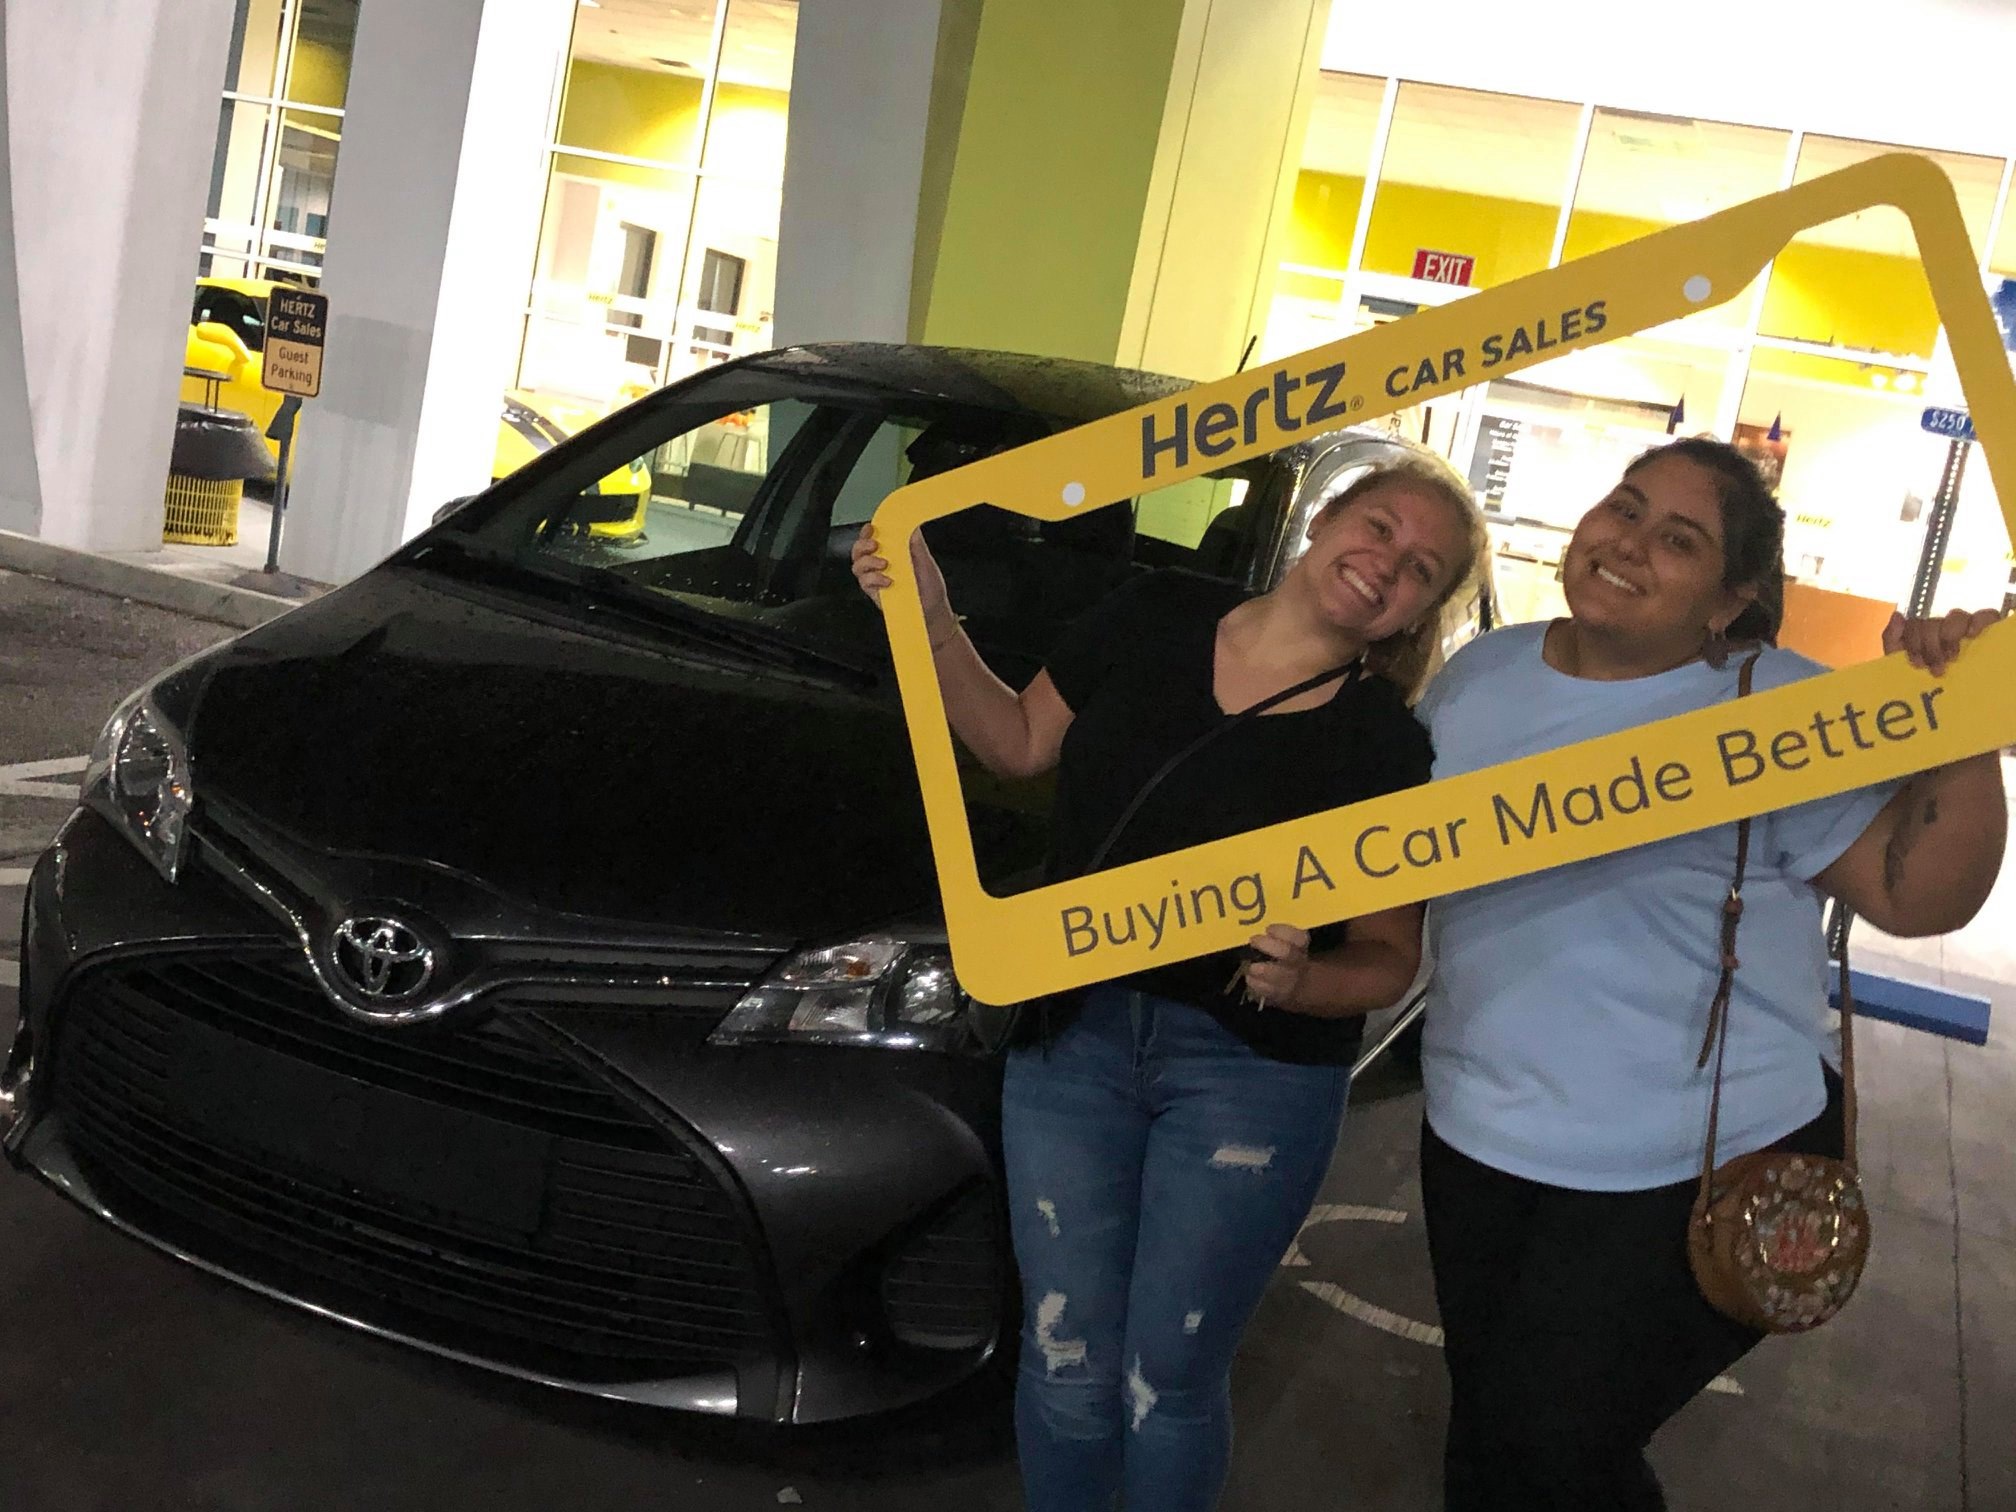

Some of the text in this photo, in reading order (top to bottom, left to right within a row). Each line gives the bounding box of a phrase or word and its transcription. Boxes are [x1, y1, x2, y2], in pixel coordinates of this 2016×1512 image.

[1422, 254, 1466, 285] EXIT
[280, 298, 316, 319] HERTZ
[271, 316, 322, 338] Car Sales
[278, 346, 309, 364] Guest
[271, 363, 312, 386] Parking
[1141, 300, 1607, 479] Hertz CAR SALES
[1061, 684, 1946, 957] Buying A Car Made Better
